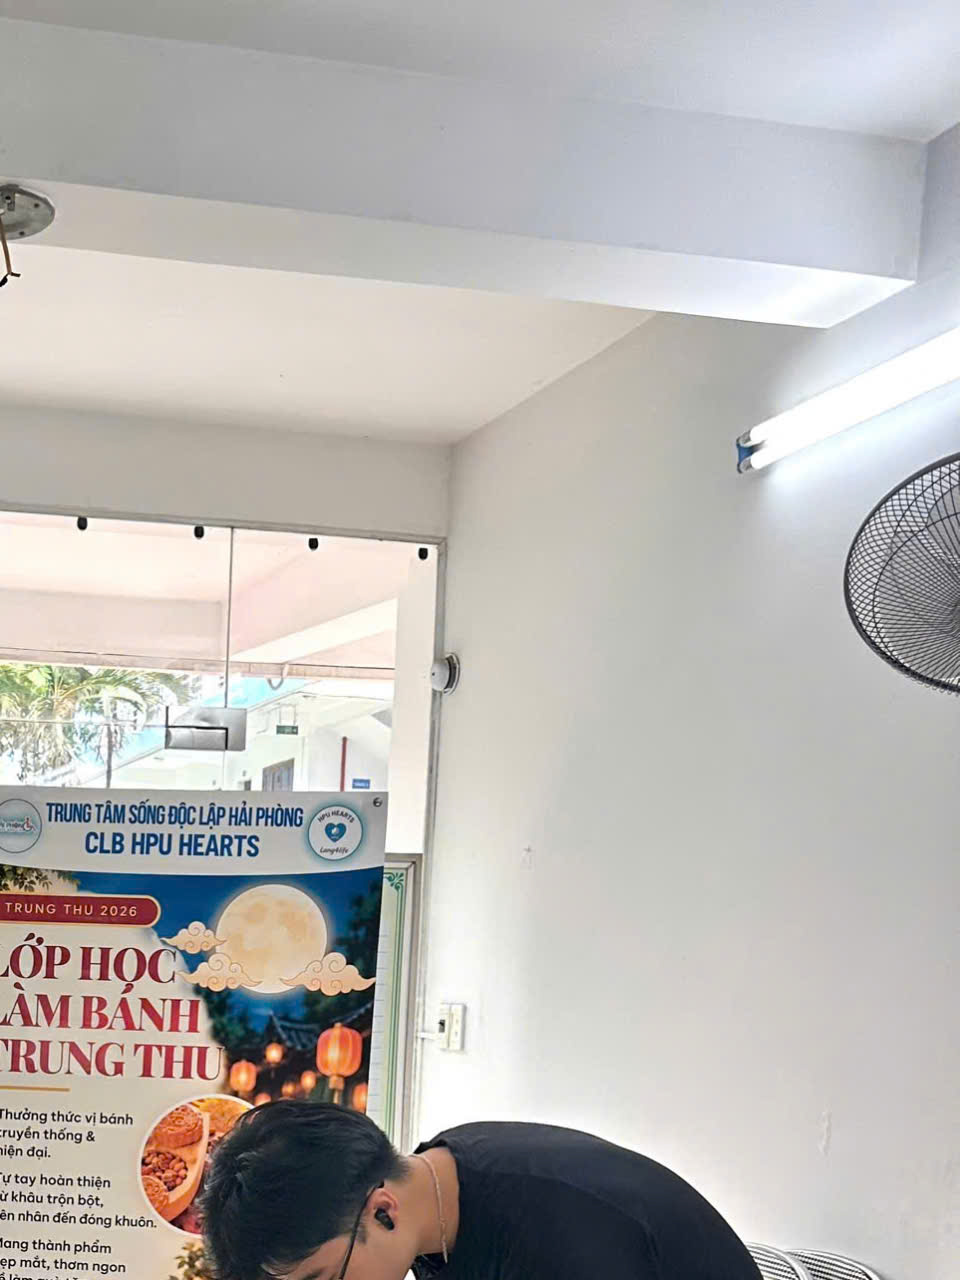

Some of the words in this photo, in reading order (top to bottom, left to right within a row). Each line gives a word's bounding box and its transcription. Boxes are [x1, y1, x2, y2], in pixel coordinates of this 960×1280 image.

[46, 802, 91, 823] TRUNG
[95, 800, 126, 824] TÂM
[128, 798, 165, 825] SỐNG
[168, 802, 196, 829] ĐỘC
[198, 802, 226, 830] LẬP
[228, 800, 252, 827] HẢI
[255, 803, 304, 828] PHÒNG
[85, 831, 124, 854] CLB
[131, 833, 172, 856] HPU
[178, 834, 260, 857] HEARTS
[5, 902, 56, 914] TRUNG
[63, 904, 93, 915] THU
[100, 905, 137, 917] 2026
[79, 946, 177, 985] HỌC
[80, 983, 201, 1033] BÁNH
[133, 1043, 225, 1080] THU
[51, 1110, 82, 1123] thức
[85, 1112, 96, 1126] vị
[99, 1112, 133, 1125] bánh
[44, 1127, 83, 1144] thống
[86, 1131, 96, 1142] &
[26, 1146, 51, 1160] đại.
[14, 1173, 36, 1187] tay
[40, 1174, 73, 1186] hoàn
[77, 1176, 111, 1190] thiện
[11, 1191, 43, 1203] khâu
[47, 1194, 74, 1207] trộn
[77, 1194, 104, 1208] bột,
[18, 1210, 49, 1223] nhân
[52, 1211, 76, 1224] đến
[79, 1213, 112, 1229] đóng
[115, 1215, 157, 1228] khuôn.
[32, 1238, 71, 1252] thành
[74, 1239, 112, 1255] phẩm
[20, 1256, 50, 1270] mắt,
[54, 1259, 89, 1271] thơm
[92, 1262, 126, 1275] ngon
